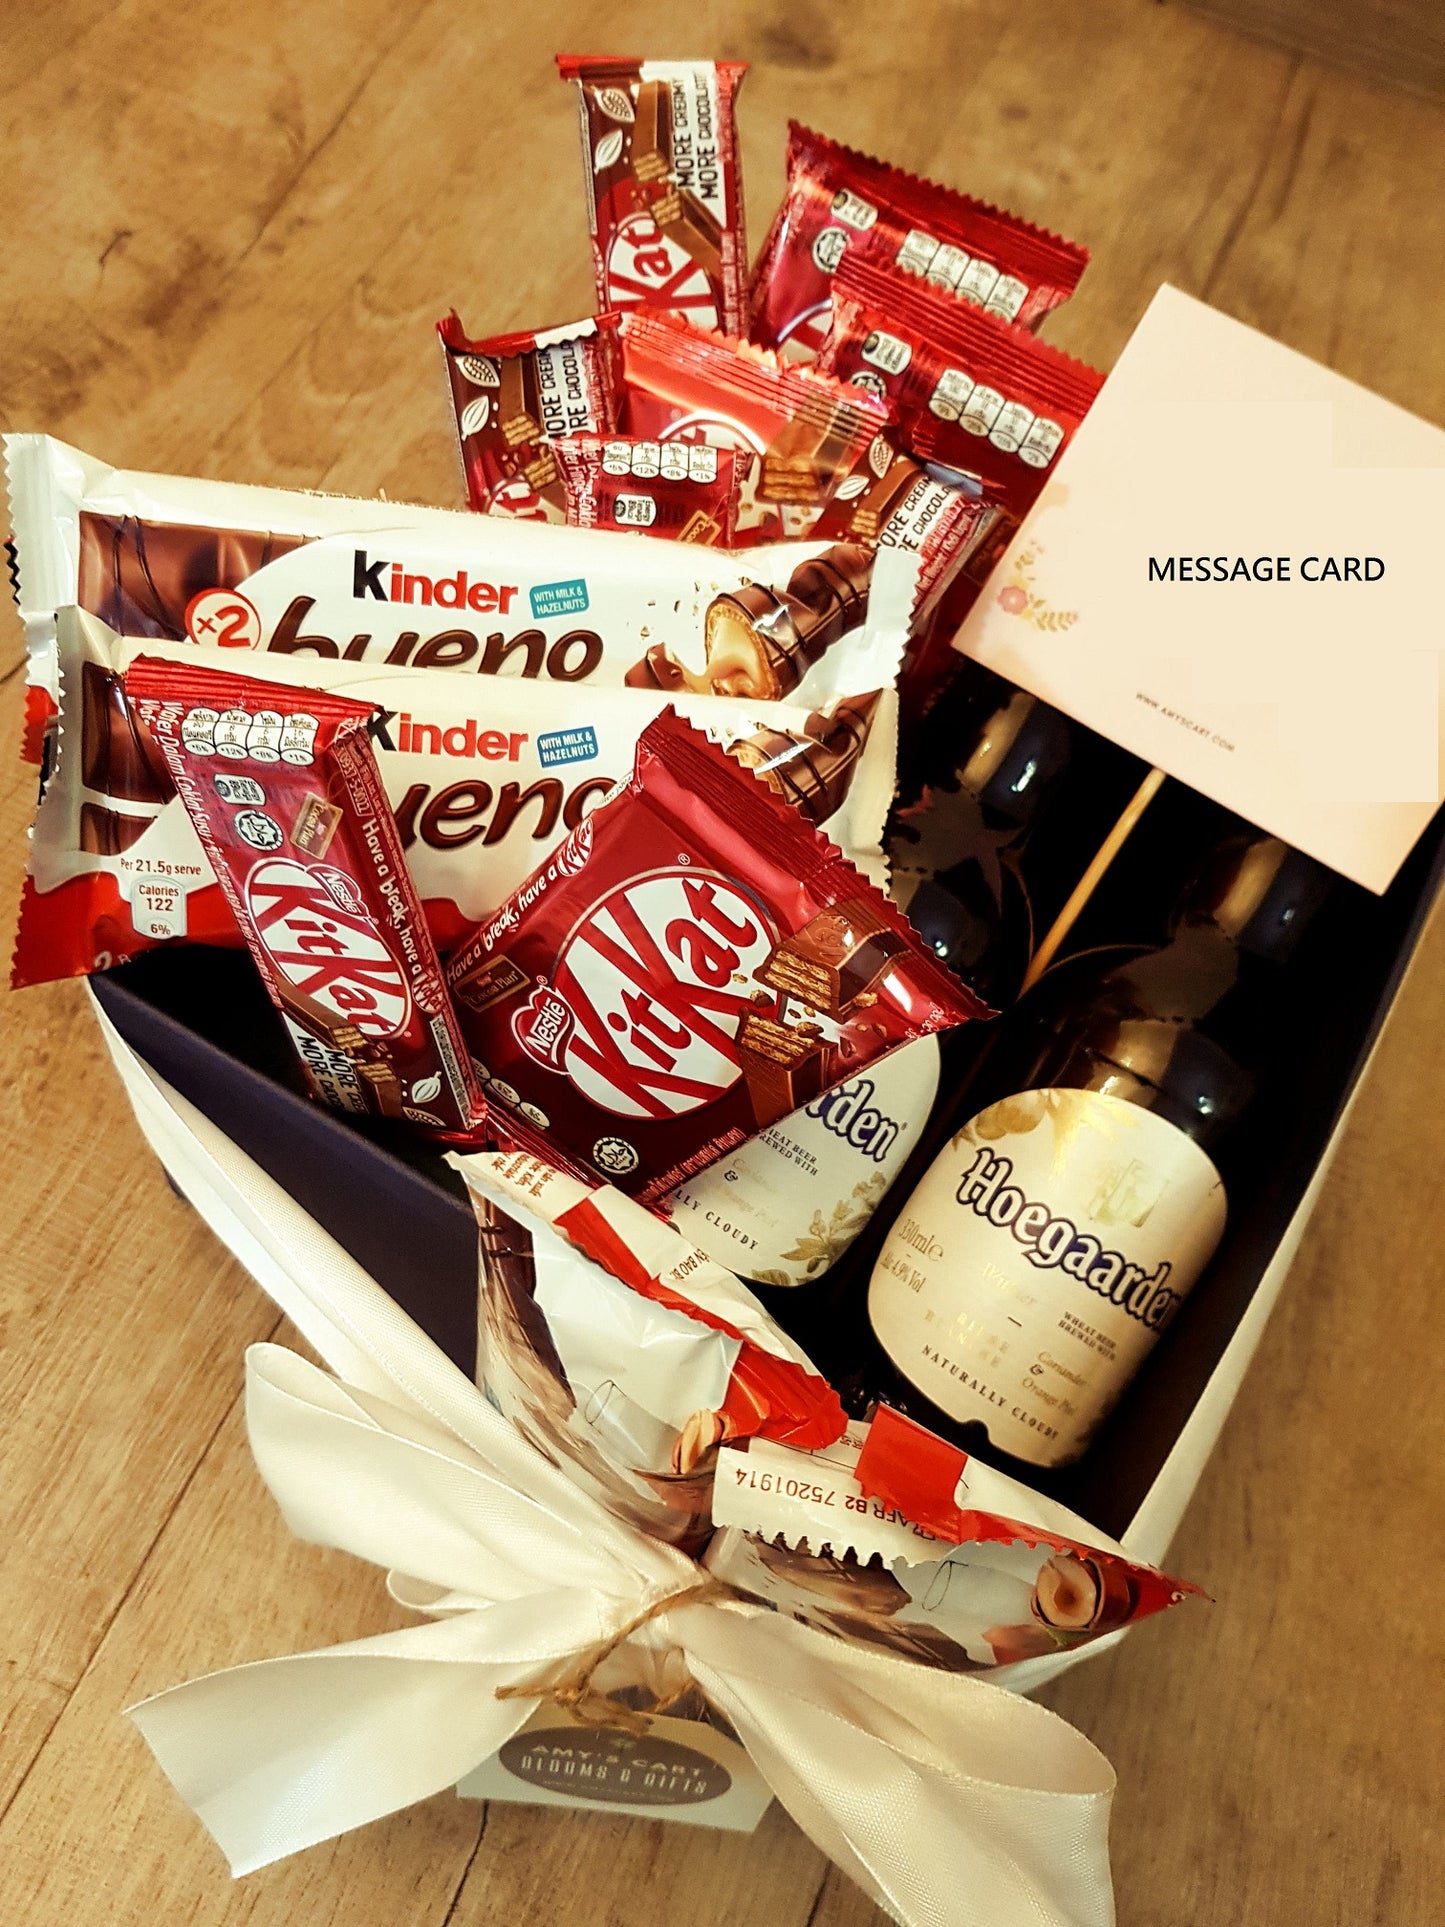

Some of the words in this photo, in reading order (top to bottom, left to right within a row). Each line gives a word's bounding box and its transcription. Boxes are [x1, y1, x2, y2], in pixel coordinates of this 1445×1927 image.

[673, 132, 694, 188] MORE
[696, 144, 720, 200] MORE
[533, 589, 554, 603] WITH
[555, 587, 577, 601] MILK
[577, 586, 584, 597] &
[535, 599, 586, 616] HAZELNUTS
[540, 736, 562, 751] WITH
[563, 733, 584, 748] MILK
[584, 731, 592, 742] &
[542, 743, 595, 763] HAZELNUTS
[120, 857, 134, 870] Per
[136, 859, 172, 876] 21.5g
[174, 861, 202, 876] serve
[138, 883, 180, 898] Calories
[362, 818, 386, 864] Have
[379, 876, 408, 929] break,
[399, 926, 416, 962] have
[146, 897, 174, 912] 122
[150, 922, 171, 937] 6%
[446, 952, 474, 986] Have
[482, 907, 520, 952] break,
[518, 878, 547, 912] have
[296, 1034, 328, 1078] MORE
[324, 1048, 354, 1090] MORE
[759, 1133, 793, 1160] REWED
[794, 1155, 819, 1176] WITH
[794, 1143, 818, 1165] BEER
[724, 1169, 739, 1182] &
[705, 1210, 760, 1251] CLOUDY
[1063, 1310, 1097, 1337] WHEAT
[922, 1344, 1007, 1408] NATURALLY
[735, 1467, 836, 1507] 75201914
[845, 1494, 867, 1514] B2
[631, 1757, 706, 1777] CART
